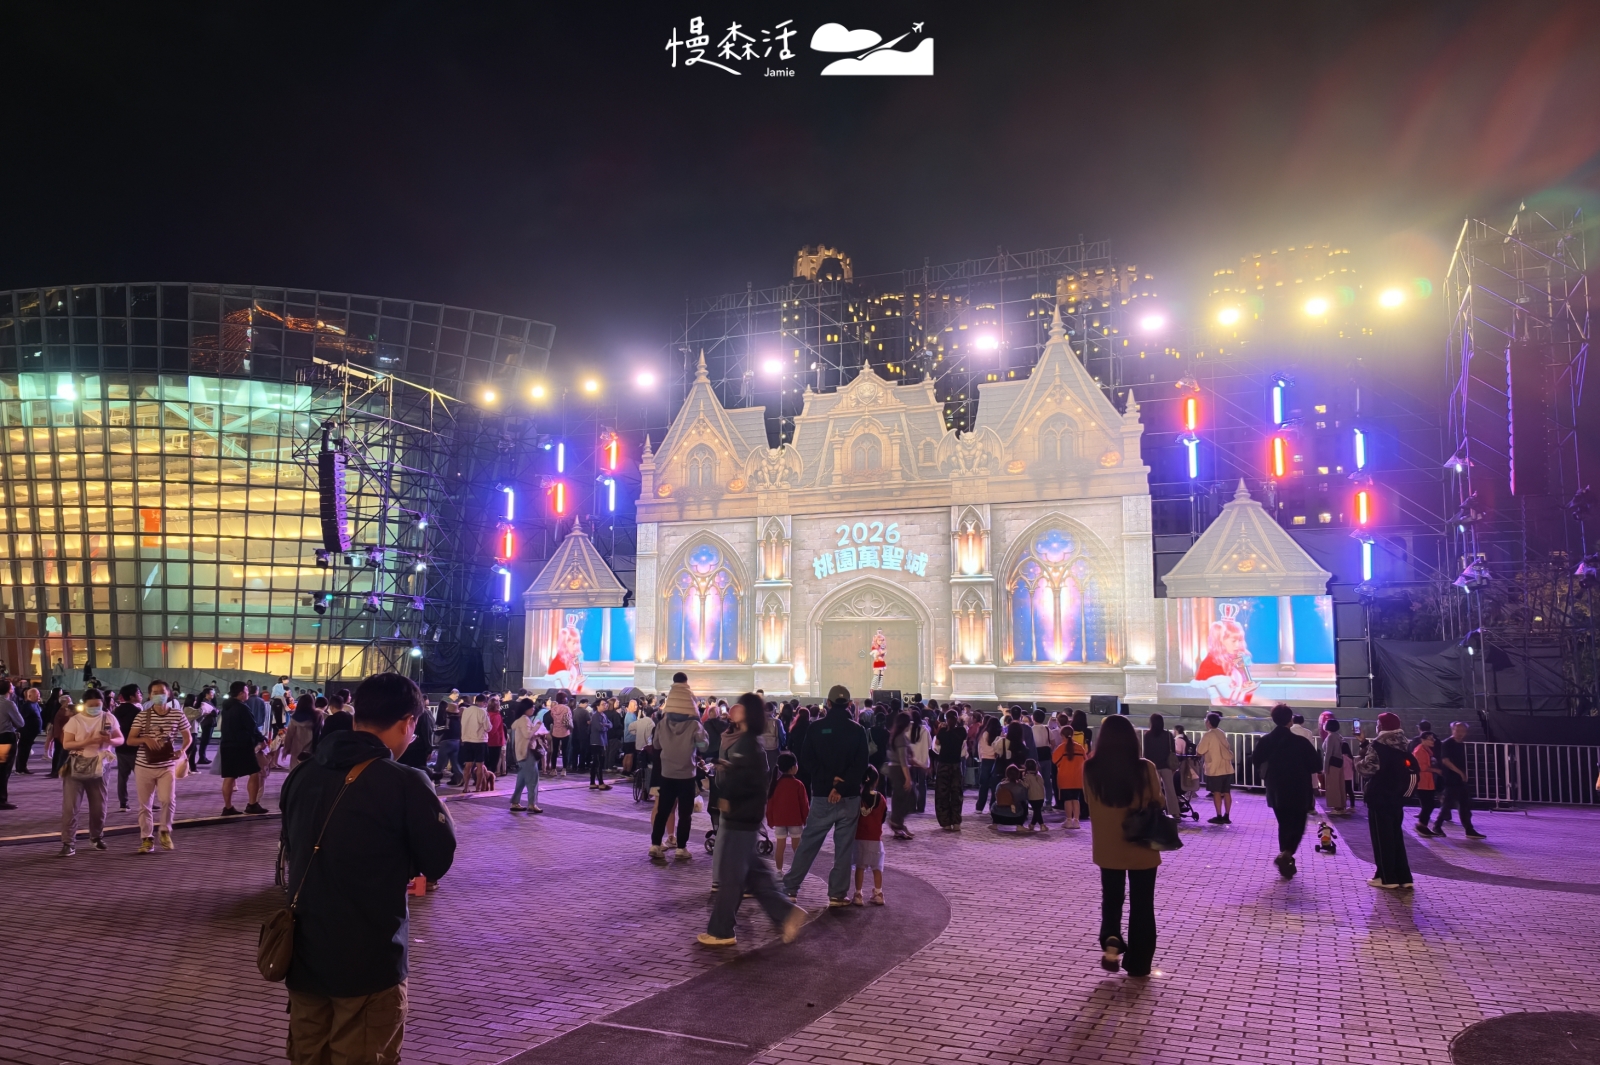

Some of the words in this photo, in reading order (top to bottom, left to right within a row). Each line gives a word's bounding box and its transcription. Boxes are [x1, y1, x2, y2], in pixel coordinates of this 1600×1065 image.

[835, 521, 901, 547] 2026
[812, 544, 929, 580] 桃園萬聖城
